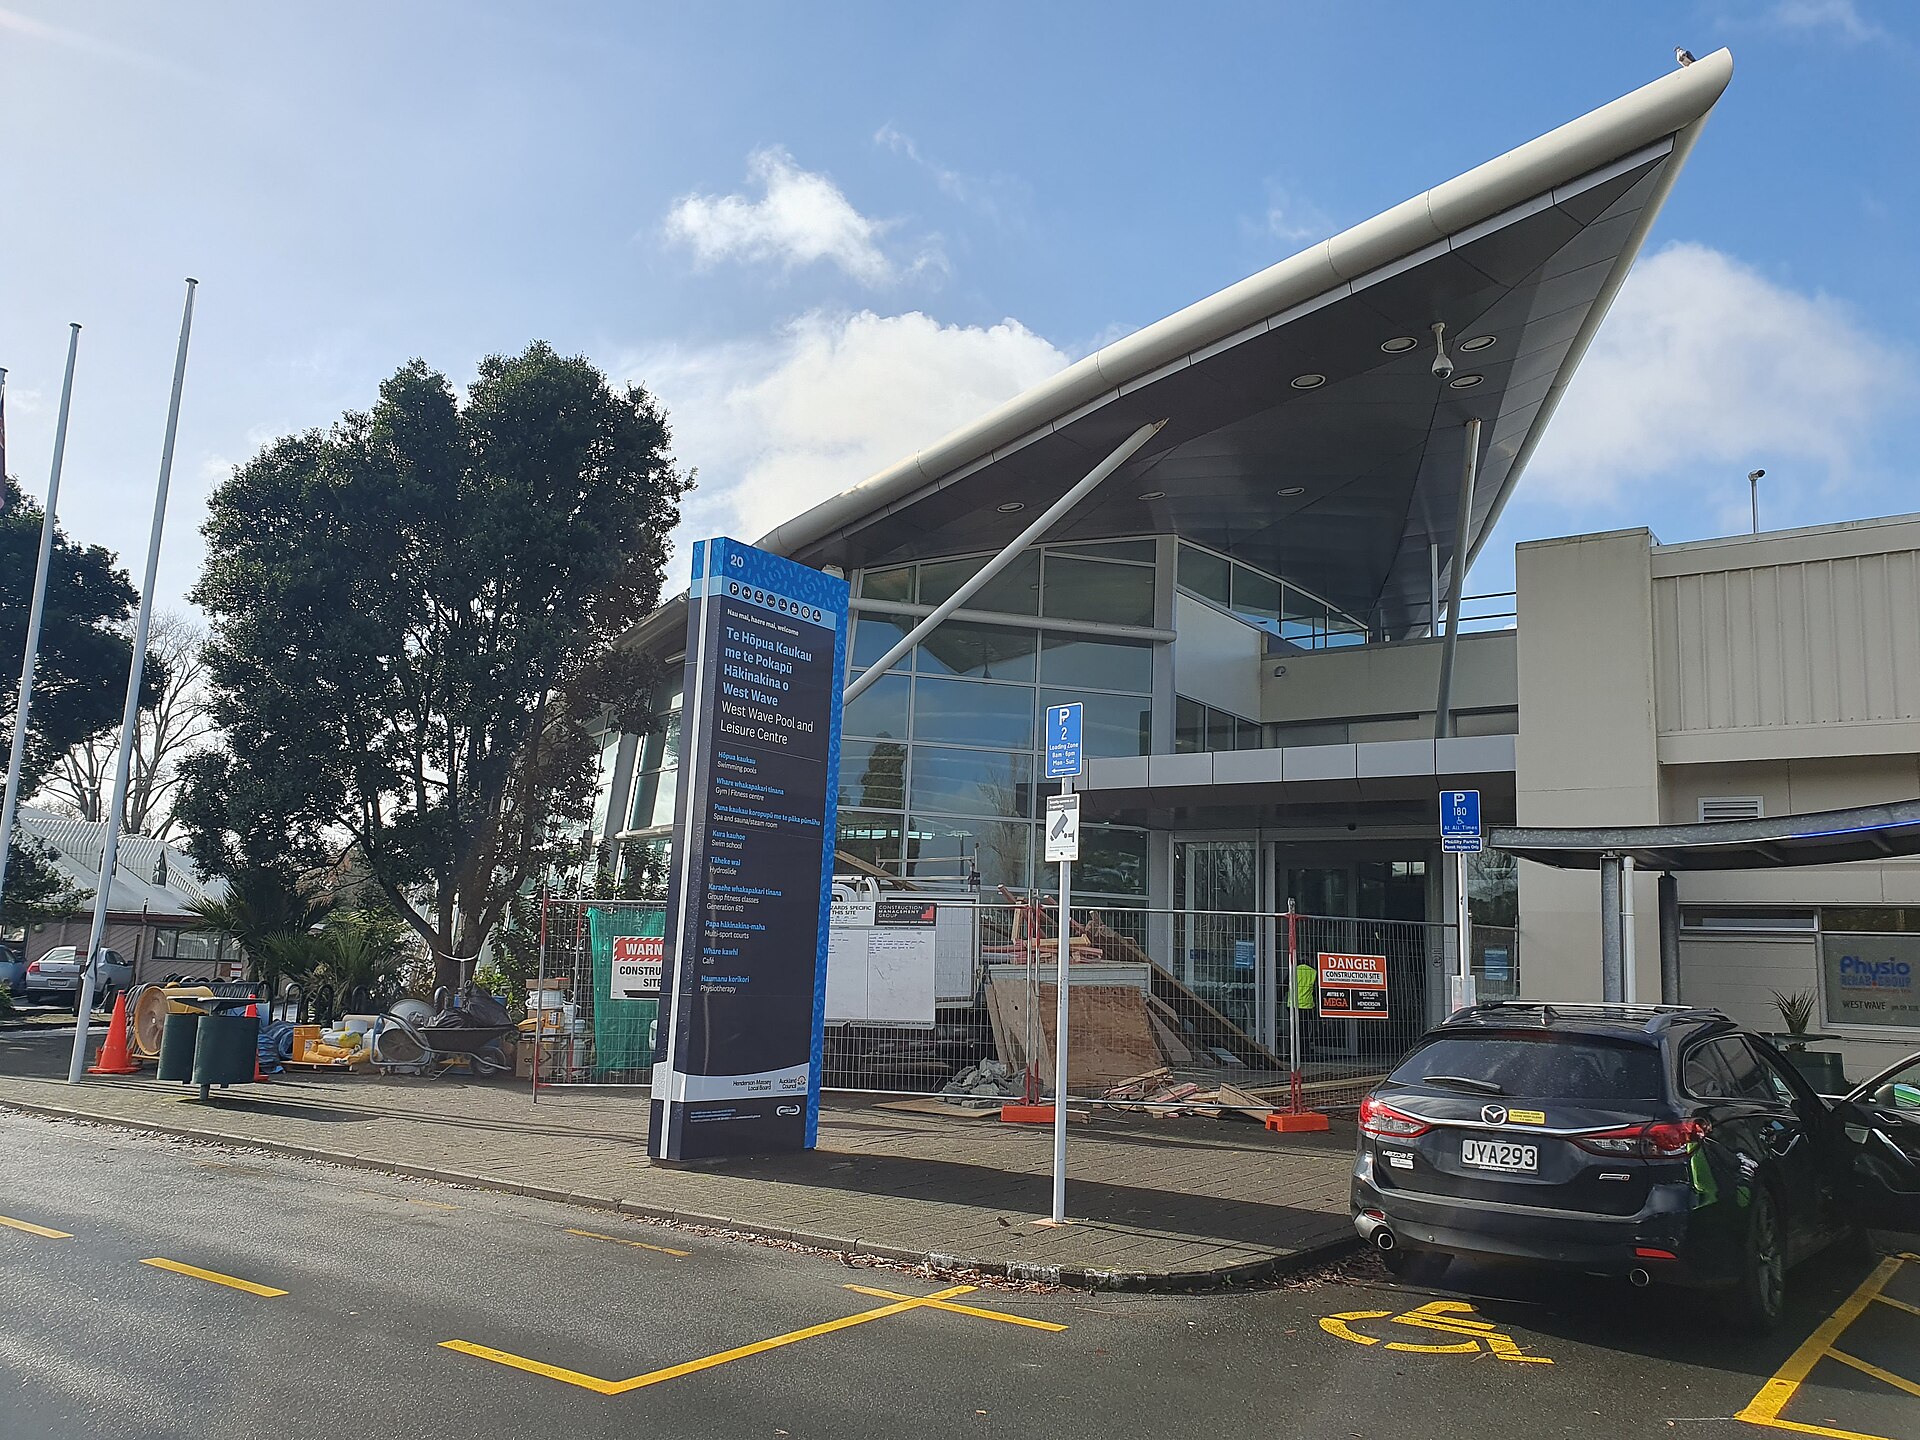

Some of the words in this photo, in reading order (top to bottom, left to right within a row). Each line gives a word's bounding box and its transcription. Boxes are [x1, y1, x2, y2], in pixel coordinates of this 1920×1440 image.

[730, 554, 744, 568] 20
[727, 608, 738, 618] Nau
[739, 612, 750, 622] mai,
[750, 616, 765, 626] haere
[766, 621, 777, 630] mai,
[777, 626, 799, 636] welcome
[726, 627, 739, 640] Te
[741, 631, 774, 652] Hōpua
[776, 641, 812, 662] Kaukau
[725, 647, 741, 660] me
[743, 651, 754, 664] te
[756, 654, 792, 674] Pokapū
[724, 663, 780, 689] Hākinakina
[783, 681, 789, 691] o
[723, 682, 749, 700] West
[751, 689, 778, 706] Wave
[721, 700, 746, 717] West
[748, 706, 773, 723] Wave
[776, 714, 795, 728] Pool
[797, 721, 813, 733] and
[1059, 708, 1070, 725] P
[720, 720, 755, 738] Leisure
[757, 727, 788, 744] Centre
[1061, 727, 1067, 740] 2
[718, 752, 736, 762] Hōpua
[736, 754, 756, 764] kaukau
[717, 760, 743, 773] Swimming
[744, 766, 757, 774] pools
[716, 777, 734, 786] Whare
[735, 780, 768, 792] whakapakari
[768, 787, 784, 795] tinana
[715, 787, 727, 796] Gym
[731, 789, 748, 799] Fitness
[749, 793, 764, 801] centre
[1454, 794, 1465, 806] P
[714, 803, 728, 811] Puna
[729, 804, 748, 815] kaukau
[749, 809, 773, 819] koropupū
[1453, 807, 1467, 816] 180
[734, 817, 764, 827] sauna/steam
[712, 830, 726, 838] Kura
[726, 831, 746, 840] kauhoe
[710, 856, 731, 865] Tāheke
[709, 866, 737, 875] Hydroslide
[708, 883, 731, 892] Karaehe
[732, 885, 765, 896] whakapakari
[707, 892, 723, 902] Group
[724, 894, 741, 902] fitness
[706, 903, 734, 911] Generation
[705, 920, 720, 928] Papa
[704, 930, 733, 938] Multi-sport
[1328, 957, 1376, 970] DANGER
[1840, 955, 1910, 980] Physio
[1326, 971, 1367, 979] CONSTRUCTION
[700, 985, 736, 994] Physiotherapy
[1323, 998, 1348, 1006] MEGA
[1465, 1144, 1535, 1167] JYA293
